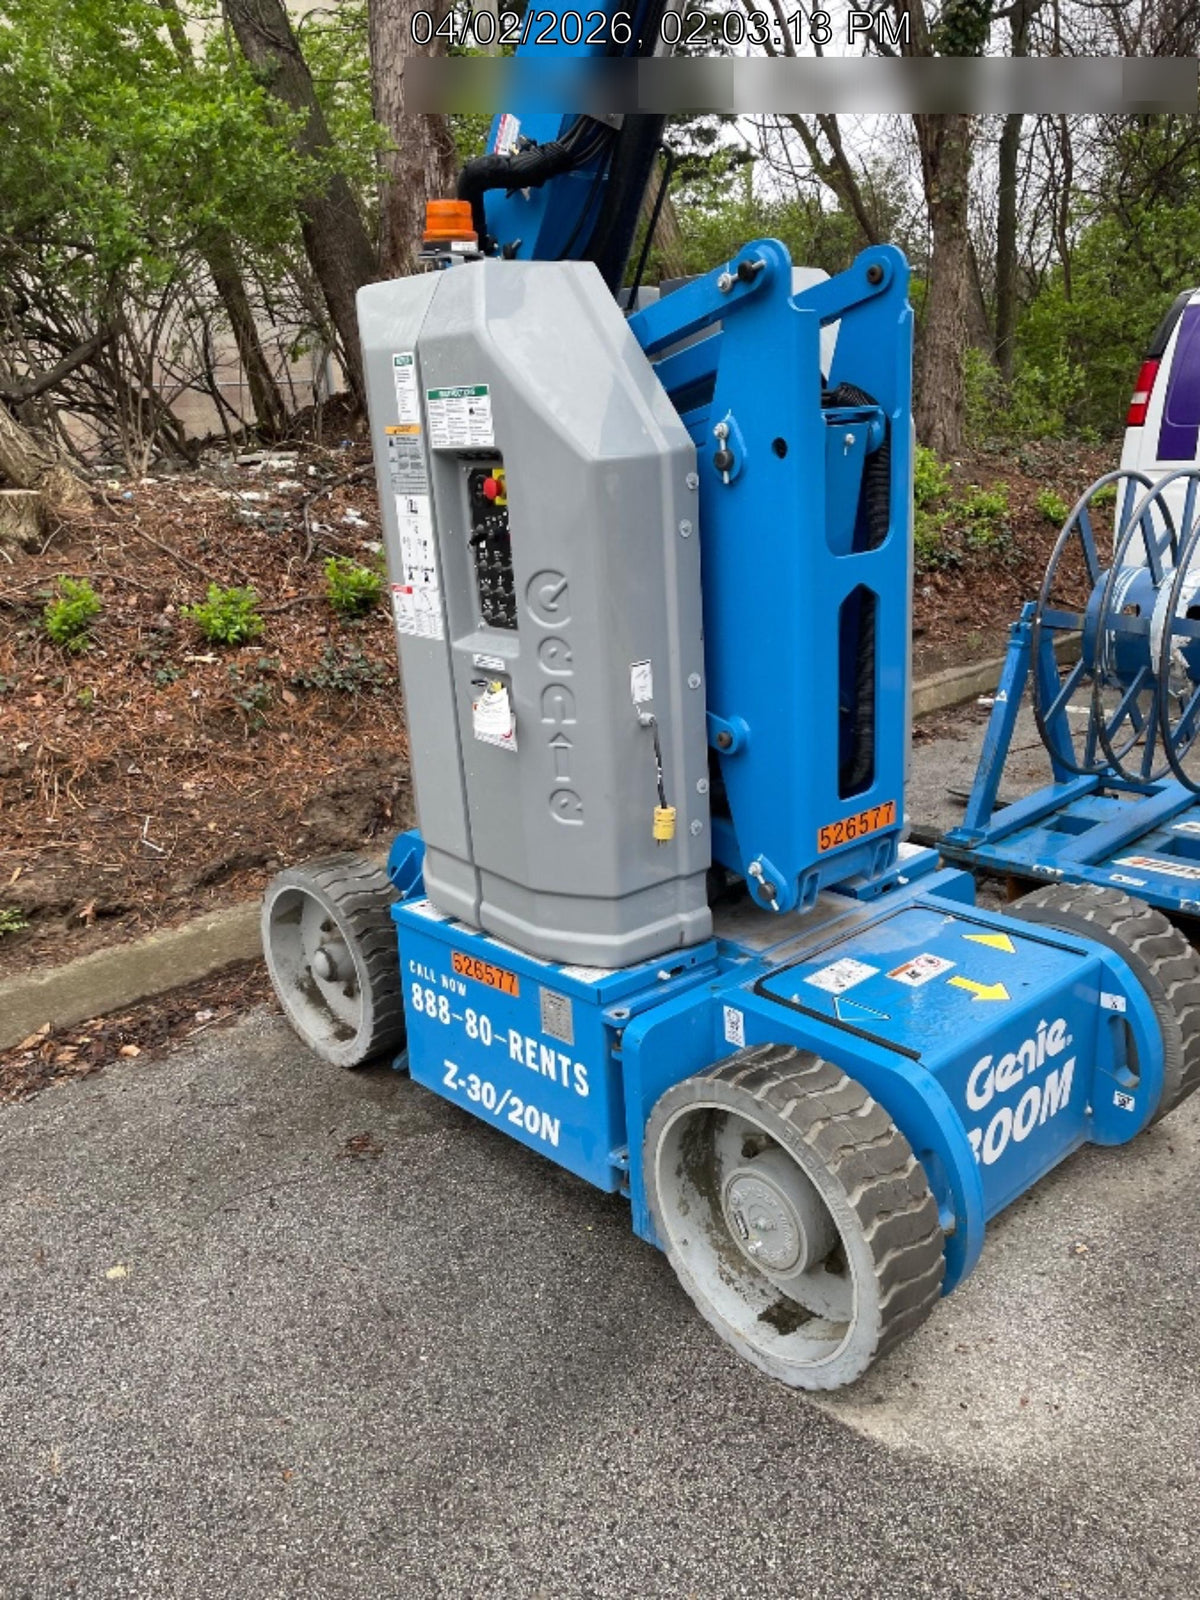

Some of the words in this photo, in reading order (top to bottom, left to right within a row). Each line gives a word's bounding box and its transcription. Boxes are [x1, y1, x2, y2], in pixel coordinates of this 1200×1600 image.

[820, 801, 893, 850] 526577
[409, 959, 436, 984] CALL
[441, 973, 467, 997] NOW
[453, 952, 517, 995] 526577
[411, 982, 590, 1097] 888-80-RENTS
[966, 1018, 1068, 1111] Genie
[443, 1059, 561, 1147] Z-30/20N
